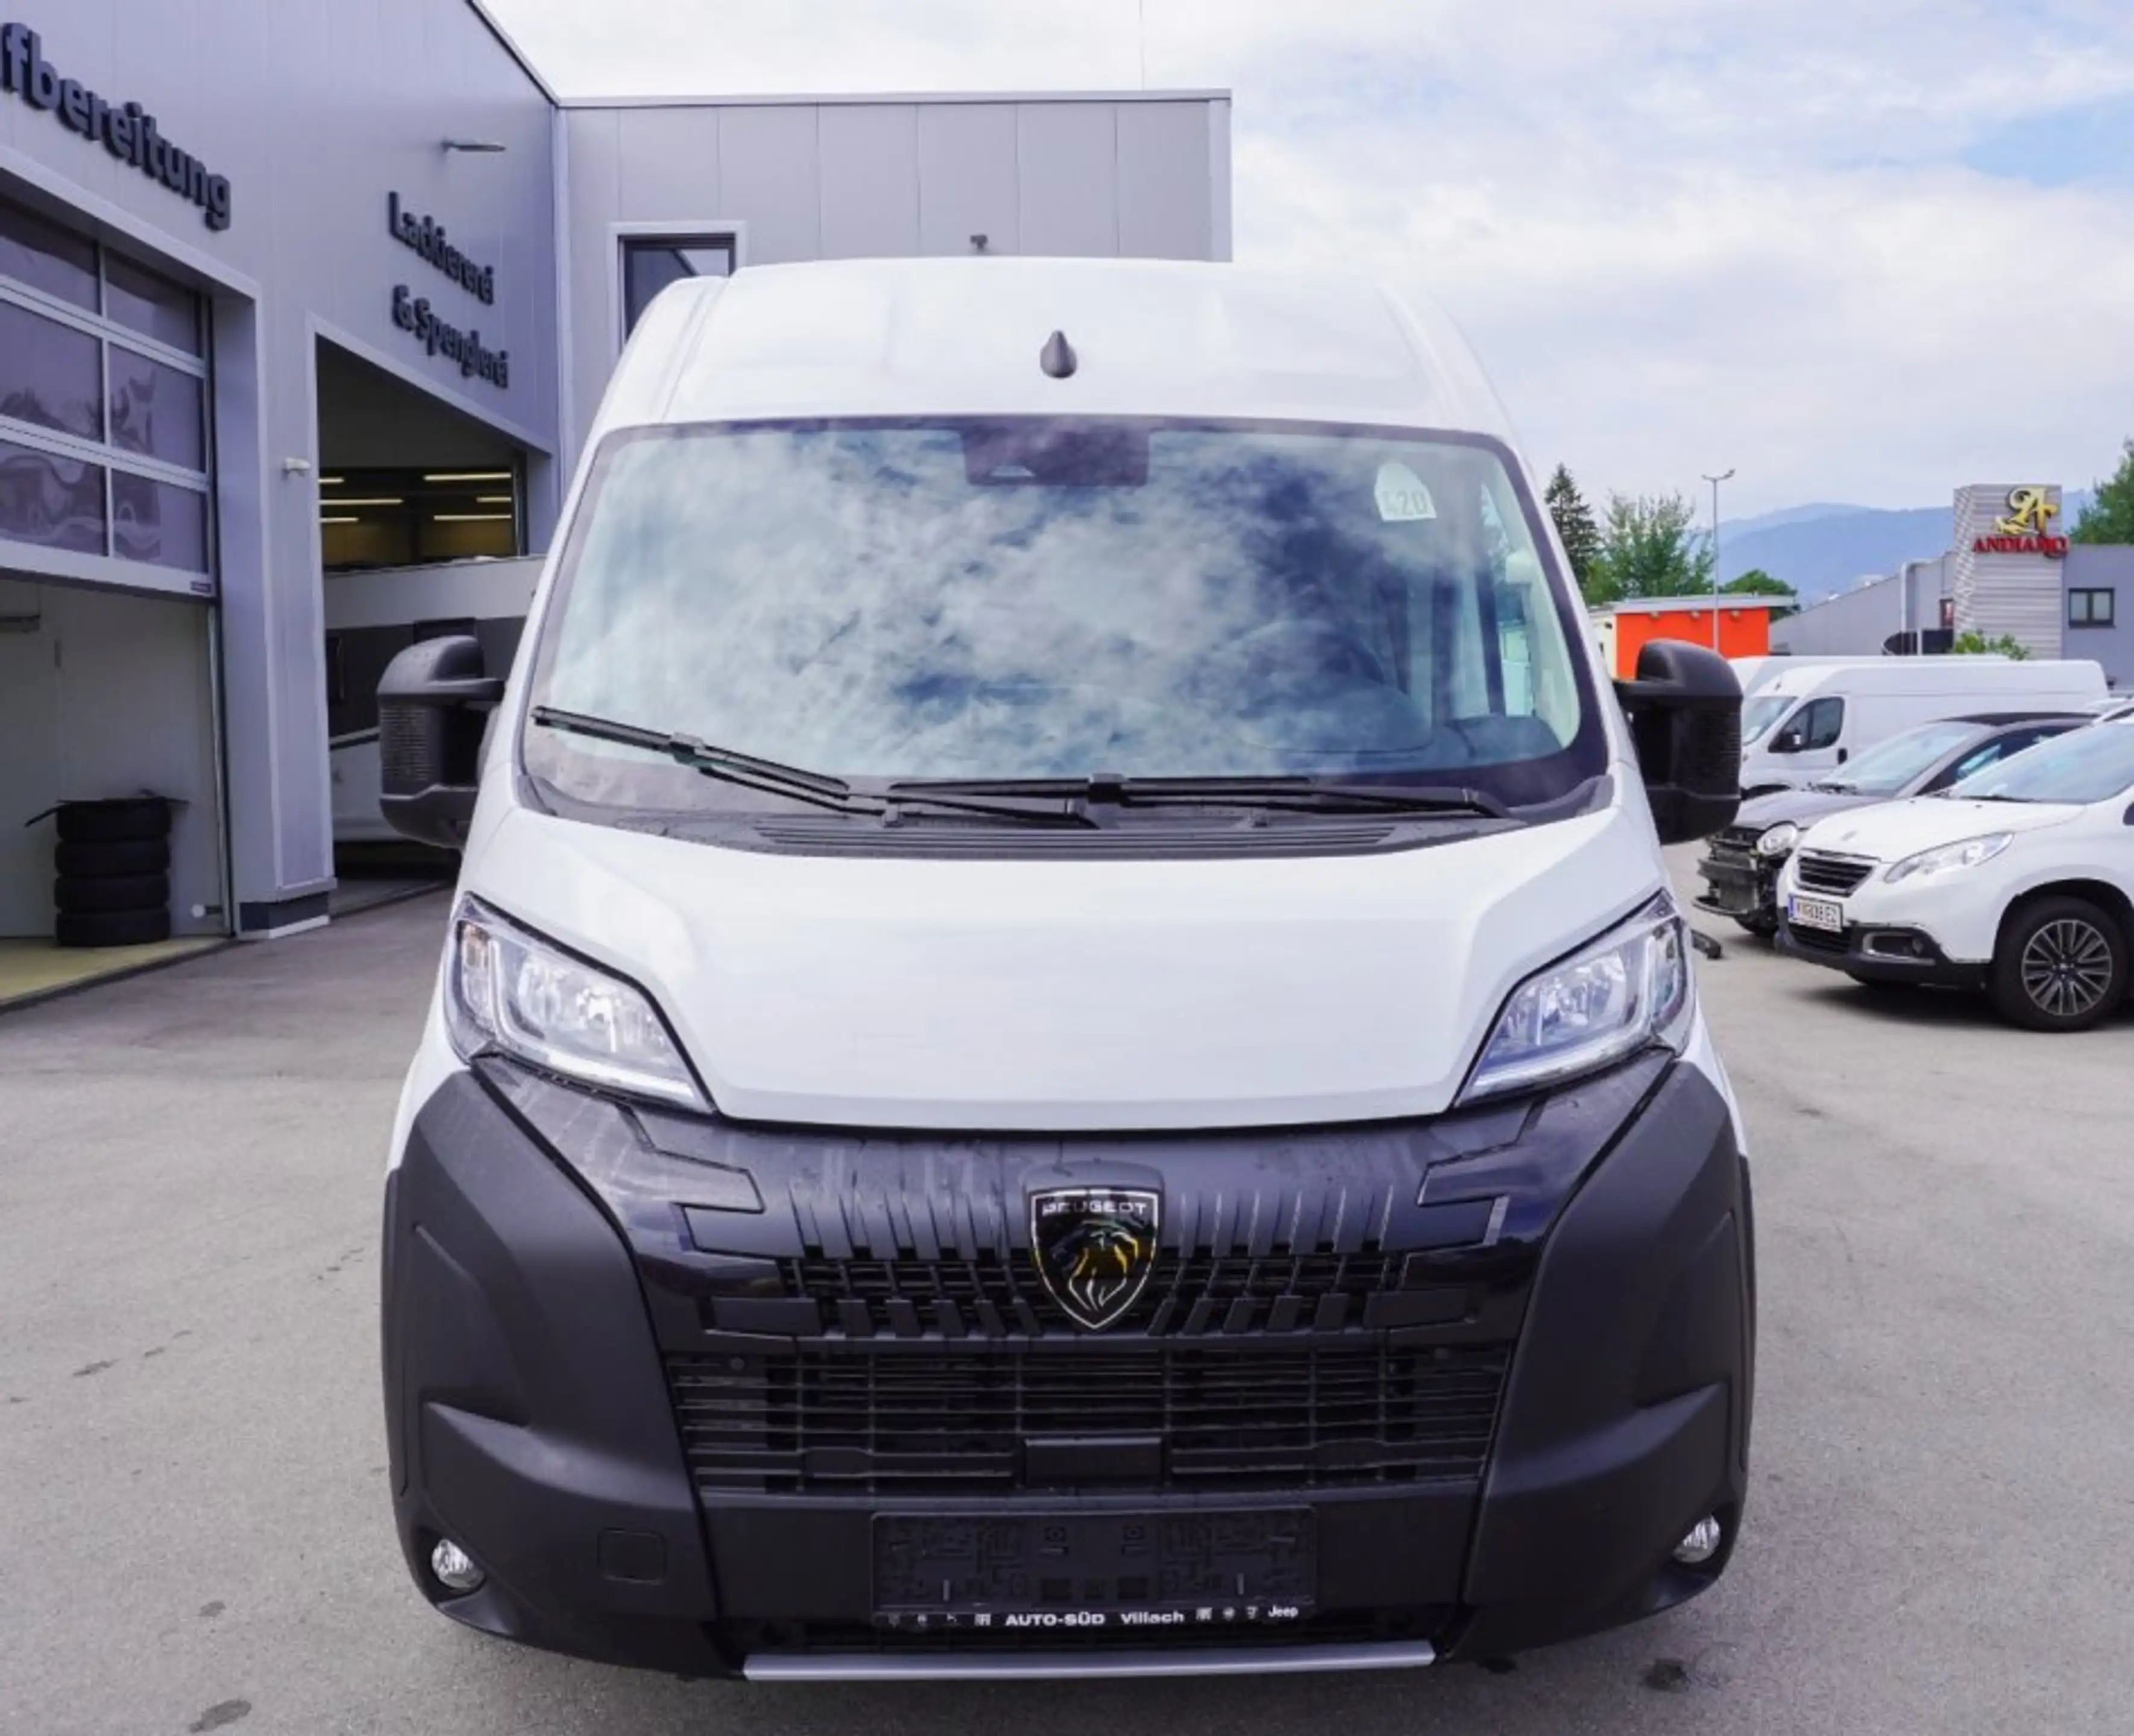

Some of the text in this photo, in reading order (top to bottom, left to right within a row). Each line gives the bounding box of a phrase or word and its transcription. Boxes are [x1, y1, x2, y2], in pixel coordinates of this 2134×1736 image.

[1042, 1200, 1147, 1216] PEUGEOT
[1005, 1605, 1298, 1626] AUTO-SÜD Villach Jeep
